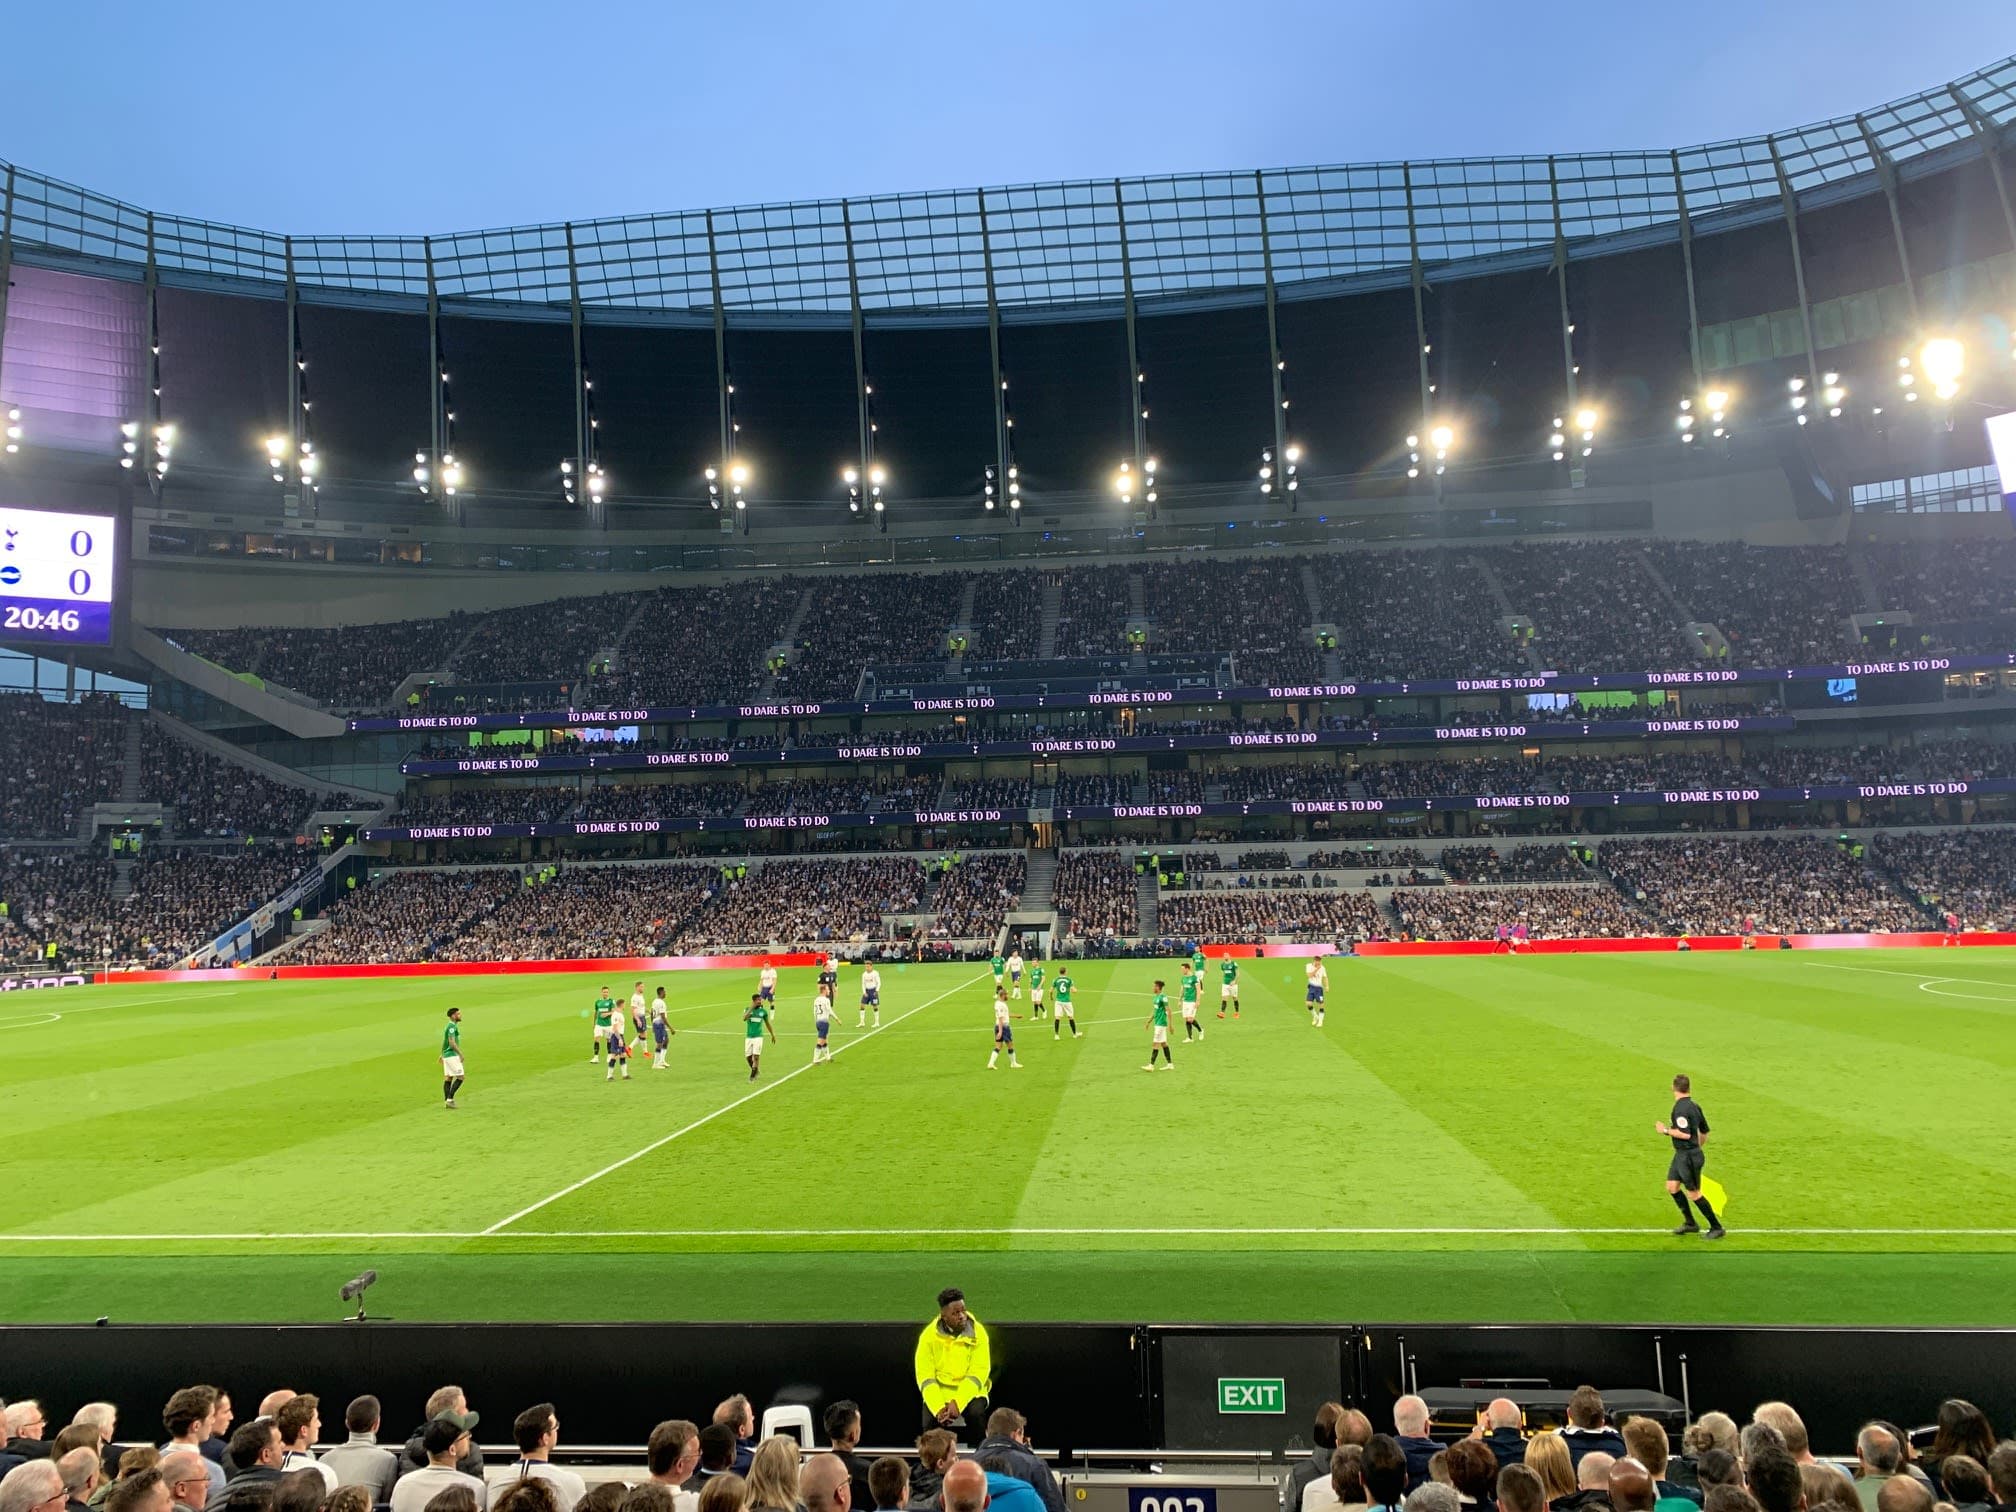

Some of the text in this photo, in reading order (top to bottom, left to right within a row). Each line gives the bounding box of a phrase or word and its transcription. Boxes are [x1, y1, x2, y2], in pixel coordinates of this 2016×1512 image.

[70, 530, 93, 557] 0
[68, 568, 91, 596] 0
[4, 606, 80, 632] 20:46
[1846, 658, 1950, 675] TO DARE IS TO DO
[1647, 671, 1738, 683] TO DARE IS TO DO
[1456, 677, 1545, 690] TO DARE IS TO DO
[1269, 685, 1356, 697] TO DARE IS TO DO
[1088, 691, 1172, 704] TO DARE IS TO DO
[740, 704, 820, 716] TO DARE IS TO DO
[913, 698, 995, 710] TO DARE IS TO DO
[399, 716, 477, 728] TO DARE IS TO DO
[568, 710, 648, 722] TO DARE IS TO DO
[1646, 719, 1739, 731] TO DARE IS TO DO
[1435, 726, 1526, 738] TO DARE IS TO DO
[1229, 733, 1317, 745] TO DARE IS TO DO
[1031, 740, 1116, 751] TO DARE IS TO DO
[647, 752, 729, 764] TO DARE IS TO DO
[838, 746, 921, 758] TO DARE IS TO DO
[458, 759, 539, 770] TO DARE IS TO DO
[1859, 782, 1968, 796] TO DARE IS TO DO
[1475, 795, 1570, 807] TO DARE IS TO DO
[1664, 790, 1759, 802] TO DARE IS TO DO
[1113, 805, 1202, 817] TO DARE IS TO DO
[1291, 800, 1383, 812] TO DARE IS TO DO
[744, 816, 829, 828] TO DARE IS TO DO
[915, 810, 1001, 822] TO DARE IS TO DO
[409, 826, 492, 838] TO DARE IS TO DO
[575, 821, 660, 833] TO DARE IS TO DO
[1060, 982, 1066, 993] 6
[1224, 1386, 1278, 1406] EXIT
